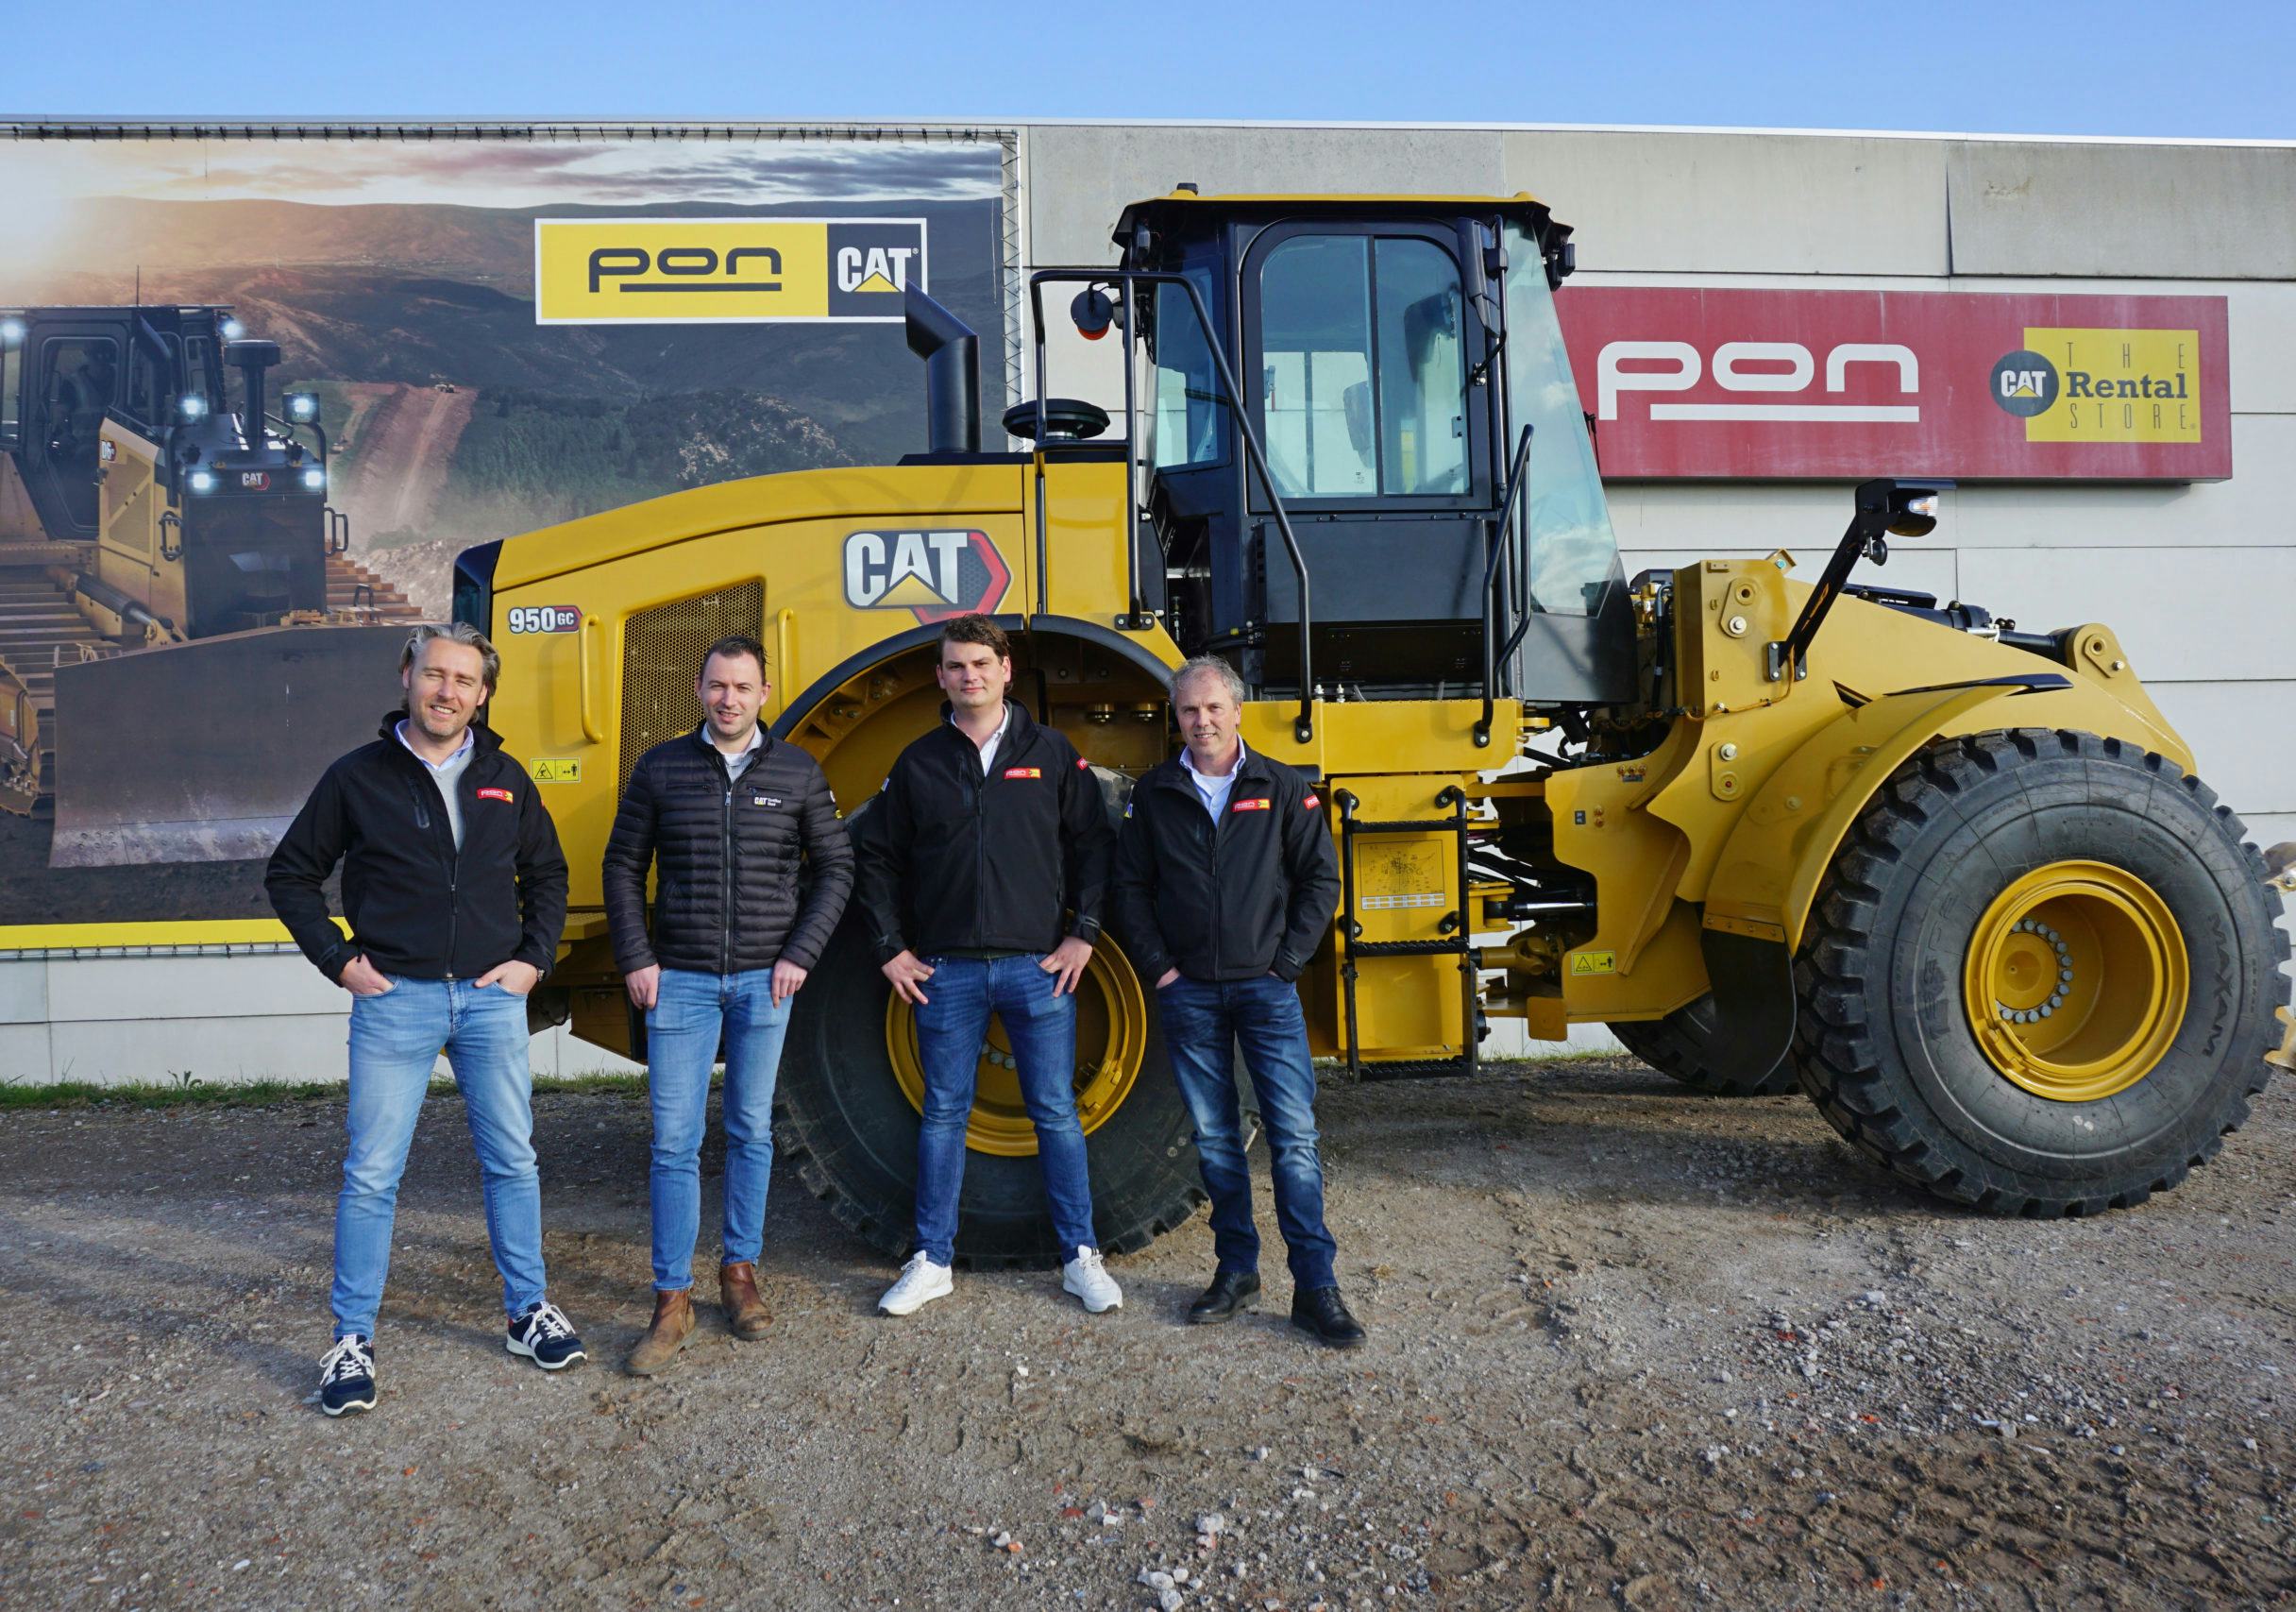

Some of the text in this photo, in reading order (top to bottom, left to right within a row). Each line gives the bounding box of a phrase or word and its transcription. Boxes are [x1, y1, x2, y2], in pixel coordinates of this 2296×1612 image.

[837, 246, 912, 293] CAT
[2066, 341, 2186, 369] THE
[2001, 369, 2047, 399] CAT
[2066, 371, 2188, 399] Rental
[2069, 402, 2187, 430] STORE
[242, 472, 263, 486] CAT
[846, 532, 968, 606] CAT
[509, 607, 575, 634] 950 GC
[2202, 912, 2234, 1058] MAXAM
